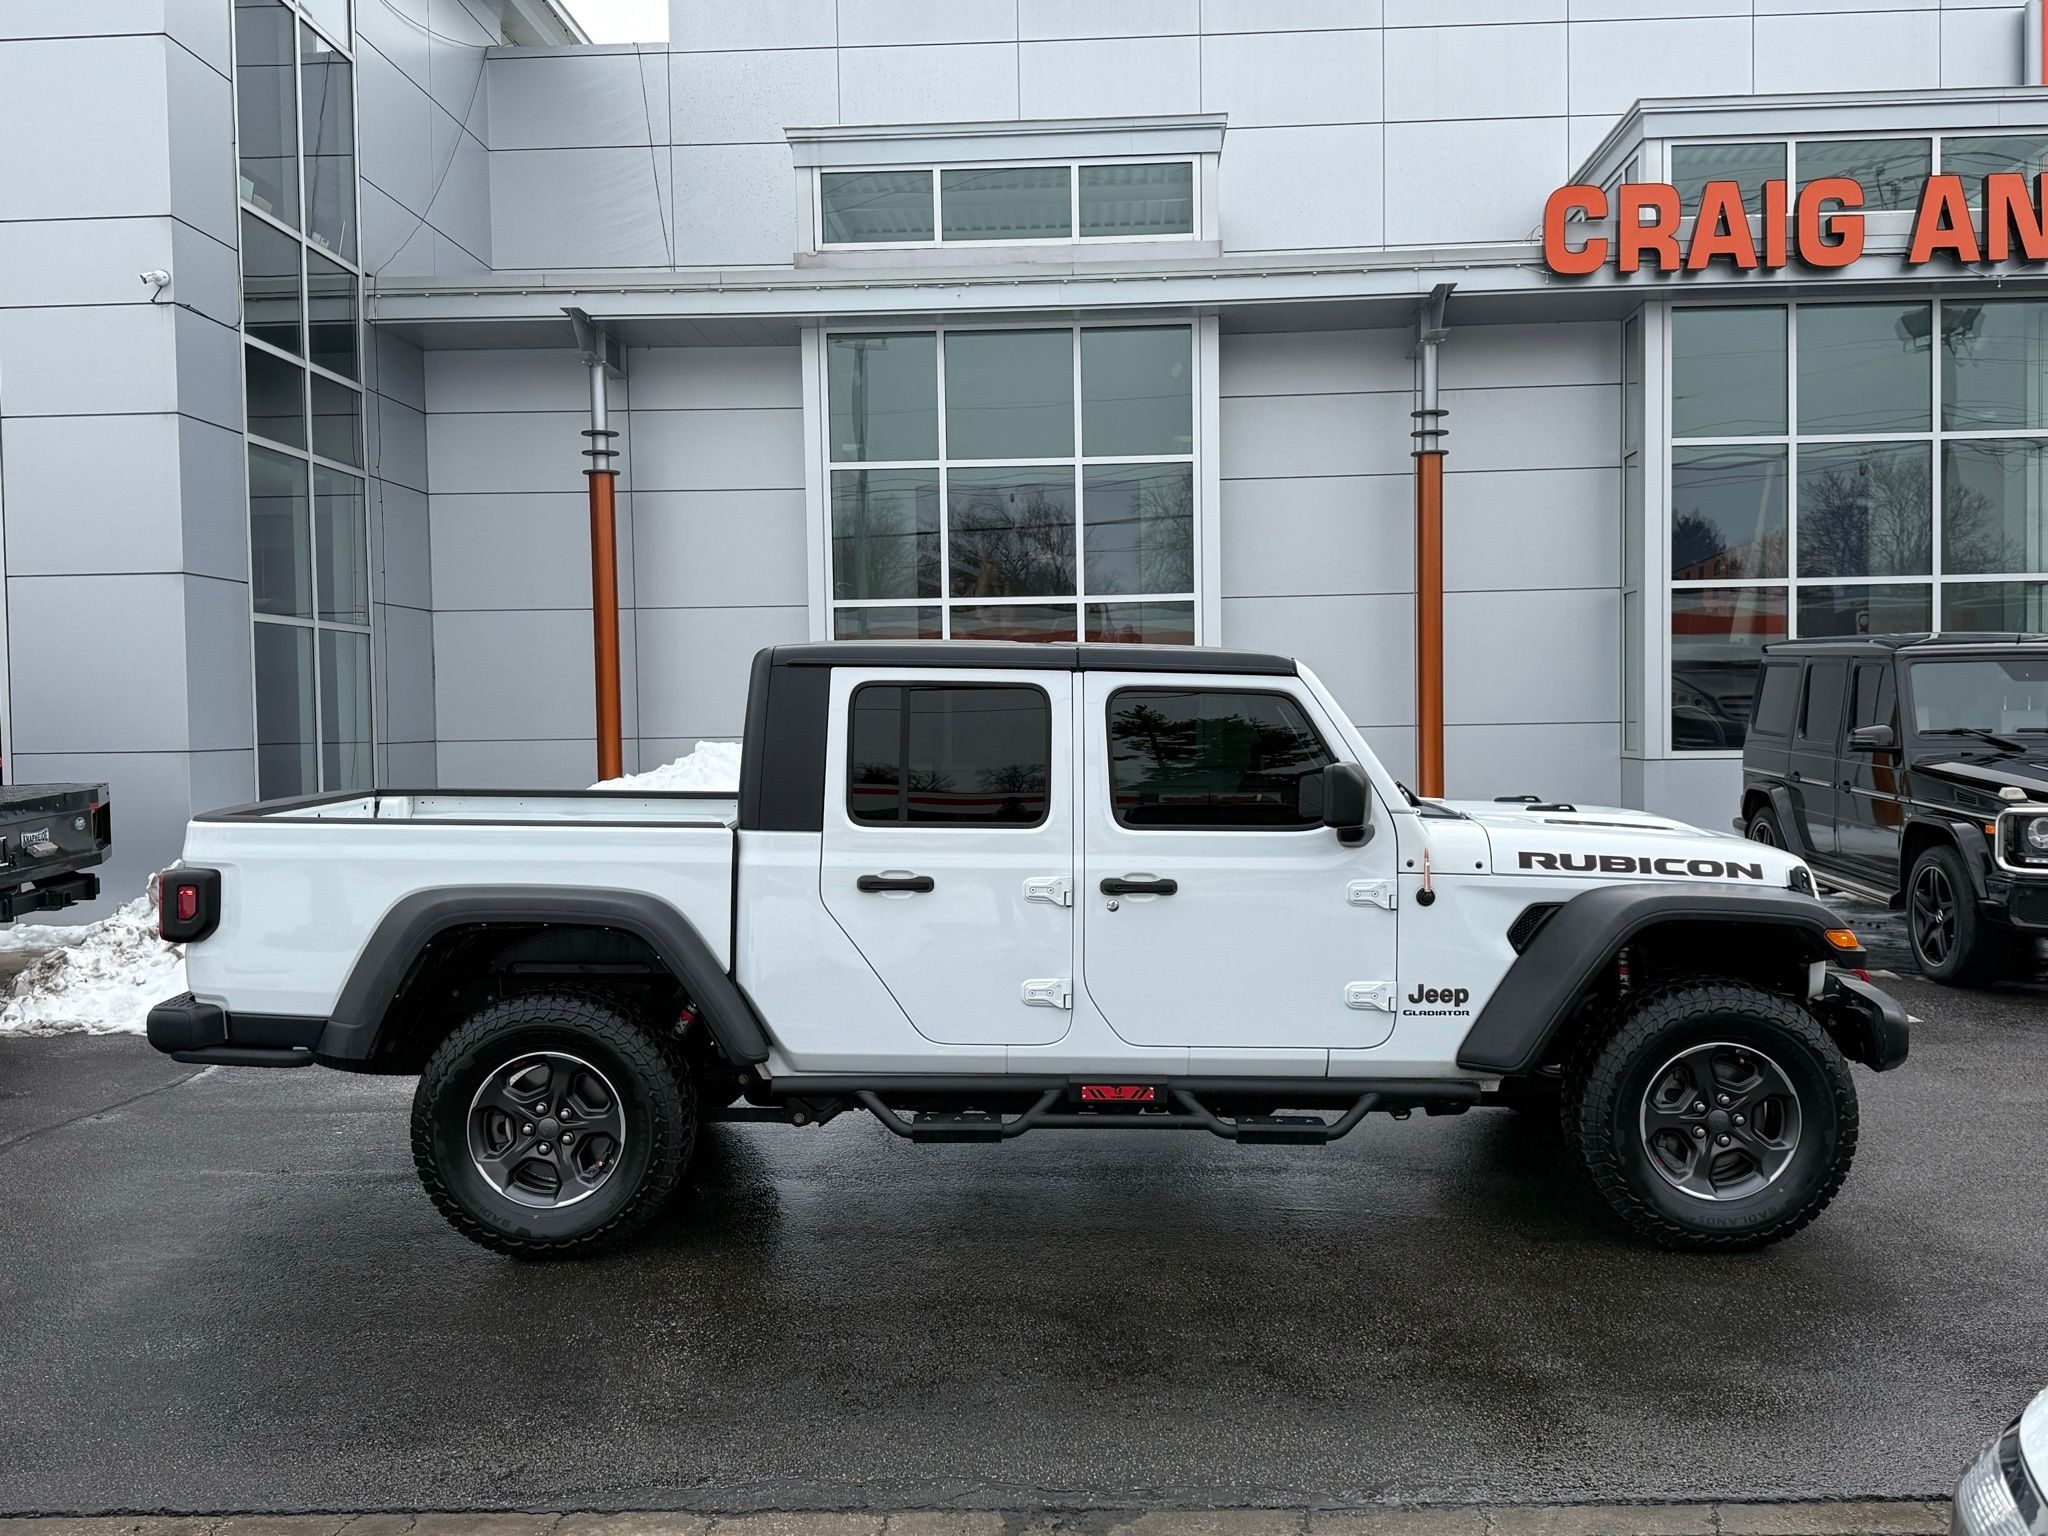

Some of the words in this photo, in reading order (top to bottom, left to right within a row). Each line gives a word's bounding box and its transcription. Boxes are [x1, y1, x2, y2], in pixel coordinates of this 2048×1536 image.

[1543, 177, 1865, 275] CRAIG
[1518, 851, 1764, 880] RUBICON
[1408, 983, 1469, 1007] Jeep
[1402, 1009, 1471, 1017] GLADIATOR
